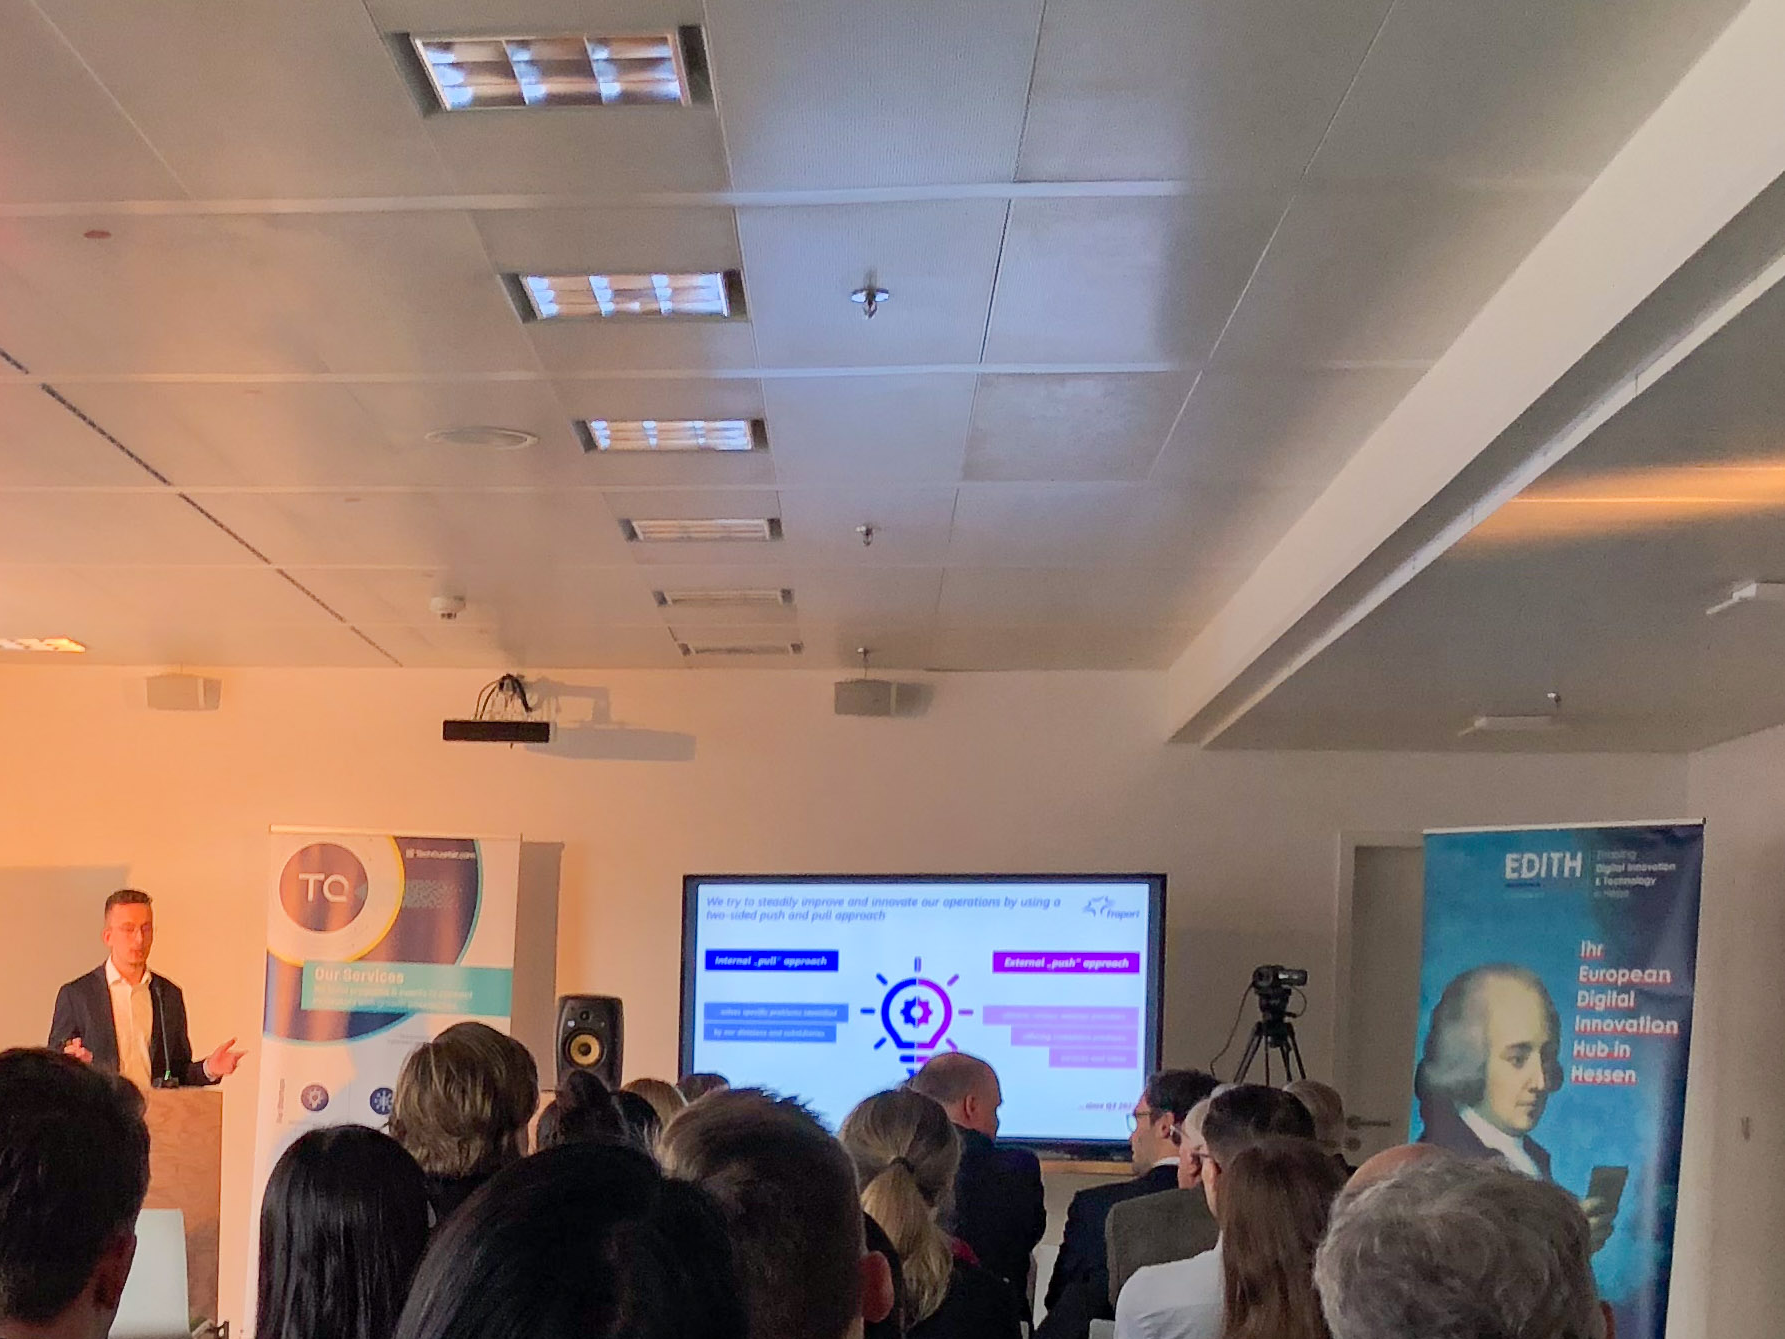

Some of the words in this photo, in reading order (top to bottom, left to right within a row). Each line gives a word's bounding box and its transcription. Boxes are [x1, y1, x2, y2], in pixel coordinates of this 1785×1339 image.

[1504, 851, 1583, 880] EDITH
[1627, 862, 1676, 872] Innovation
[1603, 875, 1656, 888] Technology
[706, 897, 724, 907] We
[726, 897, 741, 909] try
[744, 897, 755, 907] to
[758, 896, 797, 909] steadily
[801, 897, 845, 909] improve
[847, 896, 869, 907] and
[871, 897, 919, 907] innovate
[921, 898, 940, 907] our
[943, 897, 1000, 909] operations
[1004, 896, 1016, 909] by
[1020, 897, 1051, 910] using
[706, 910, 757, 921] two-sided
[758, 910, 786, 923] push
[788, 910, 809, 921] and
[811, 910, 832, 923] pull
[835, 910, 886, 923] approach
[1580, 940, 1605, 958] Ihr
[715, 956, 752, 966] Internal
[783, 957, 827, 968] approach
[1003, 957, 1046, 968] External
[1083, 958, 1130, 970] approach
[314, 966, 339, 982] Our
[343, 967, 405, 984] Services
[1578, 965, 1672, 986] European
[1576, 989, 1635, 1010] Digital
[1574, 1014, 1679, 1035] Innovation
[1573, 1040, 1609, 1058] Hub
[1613, 1040, 1631, 1058] in
[1571, 1064, 1637, 1083] Hessen
